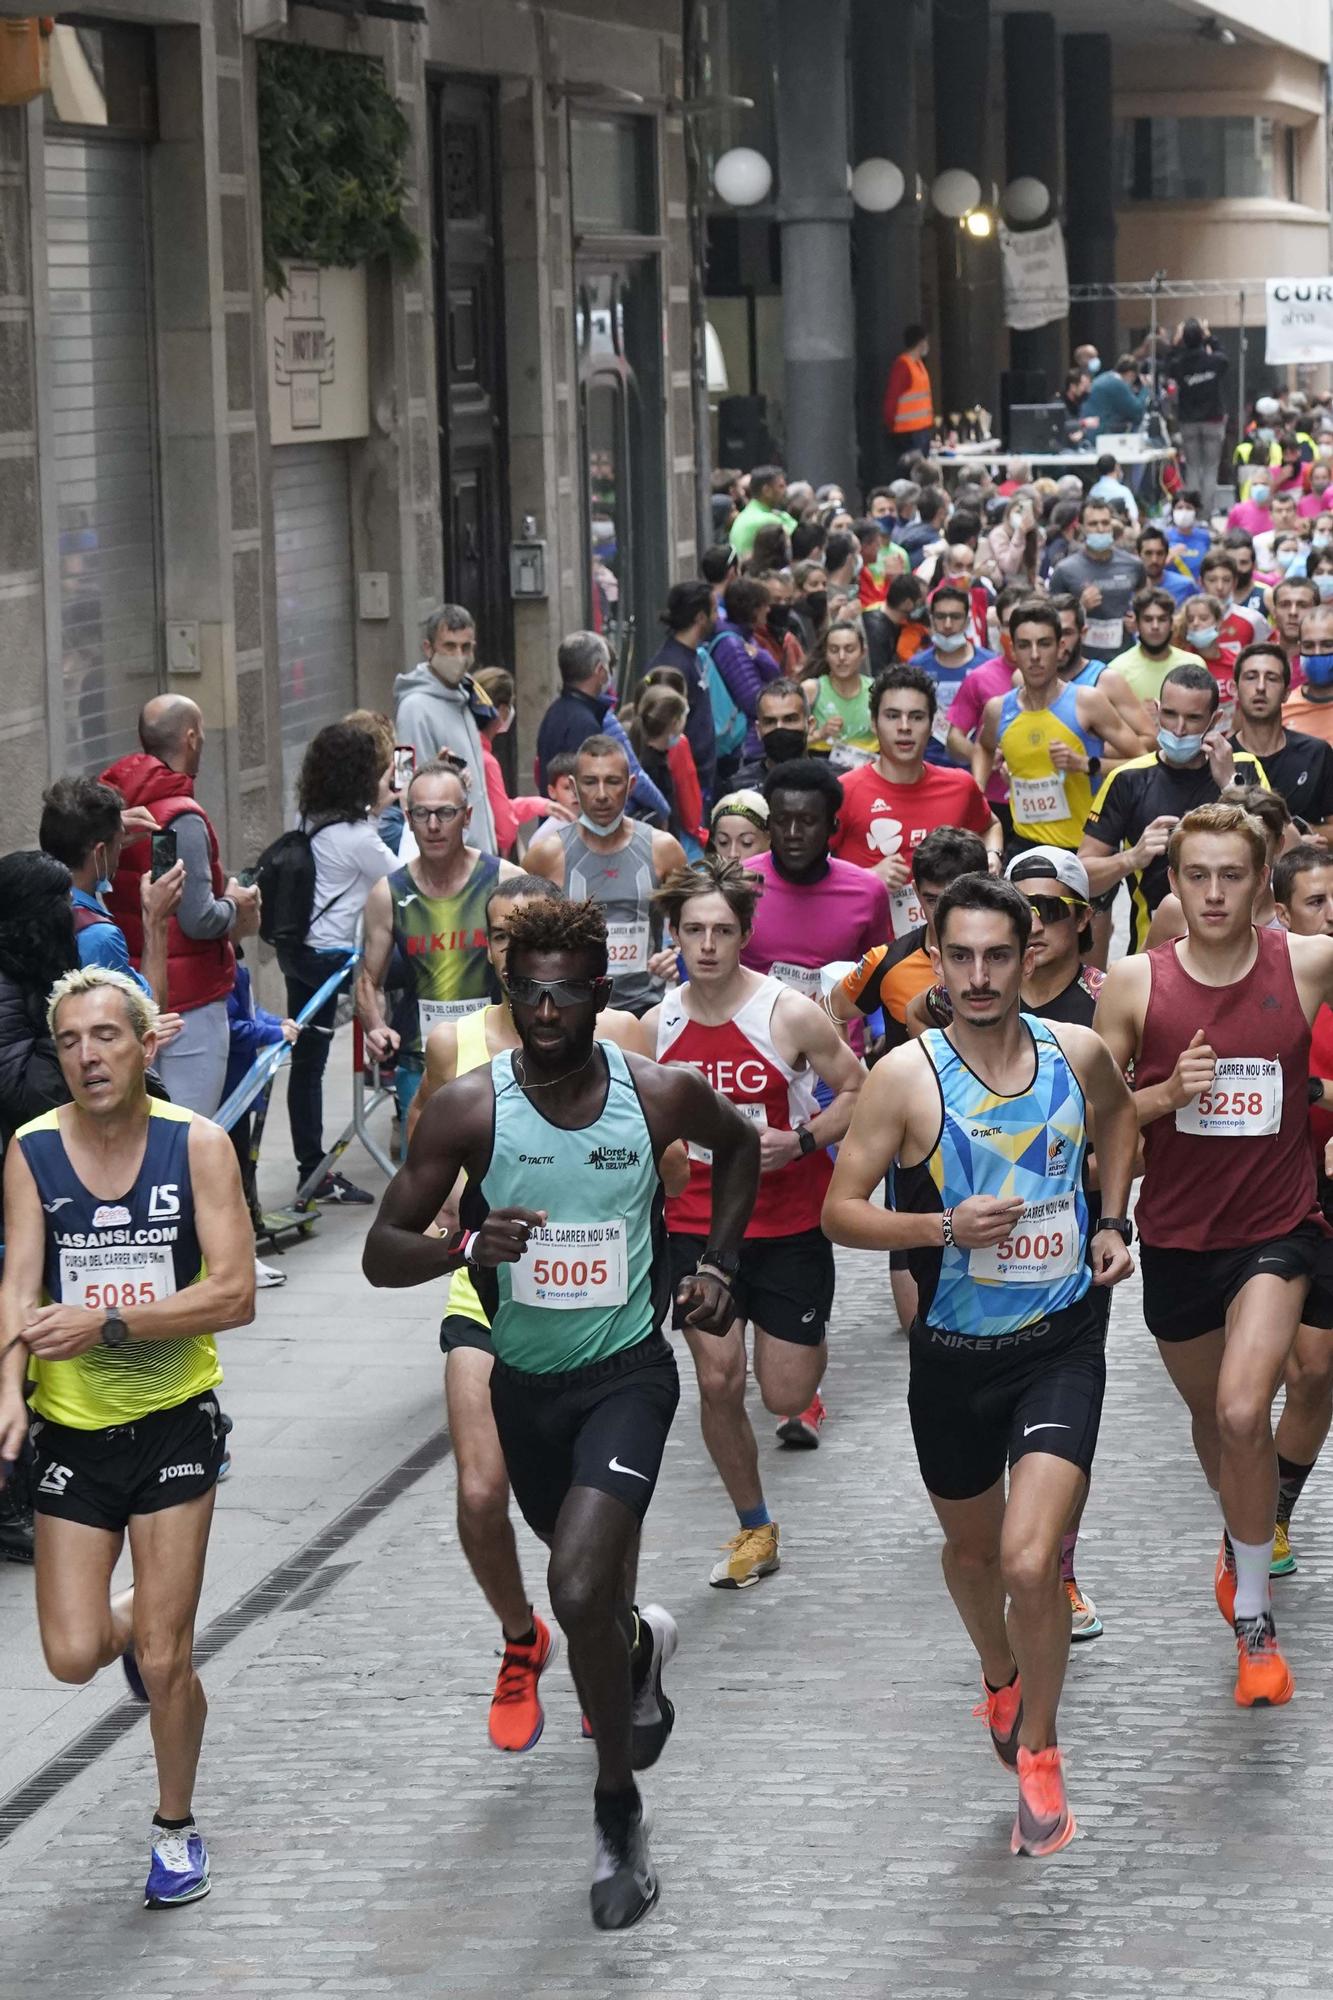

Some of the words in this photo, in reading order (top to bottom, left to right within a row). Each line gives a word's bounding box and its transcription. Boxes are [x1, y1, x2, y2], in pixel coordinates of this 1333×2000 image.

[1274, 286, 1333, 302] CUR
[1022, 796, 1056, 812] 5182
[1219, 1064, 1244, 1076] CARRER
[1246, 1064, 1260, 1076] NOU
[1262, 1064, 1276, 1076] 5Km
[1198, 1092, 1263, 1116] 5258
[1209, 1118, 1246, 1128] montepio
[980, 1126, 1003, 1138] TACTIC
[528, 1155, 555, 1165] TACTIC
[605, 1162, 627, 1170] SELVA
[148, 1184, 180, 1217] LS
[54, 1226, 178, 1248] LASANSI.COM
[540, 1229, 553, 1242] DEL
[556, 1229, 586, 1243] CARRER
[588, 1229, 604, 1242] NOU
[605, 1228, 620, 1241] 5Km
[997, 1232, 1064, 1260] 5003
[65, 1255, 87, 1267] CURSA
[89, 1254, 102, 1267] DEL
[104, 1252, 130, 1265] CARRER
[132, 1252, 147, 1264] NOU
[149, 1251, 165, 1263] 5Km
[533, 1260, 607, 1286] 5005
[1009, 1263, 1047, 1275] montepio
[84, 1282, 155, 1309] 5085
[547, 1289, 588, 1300] montepio
